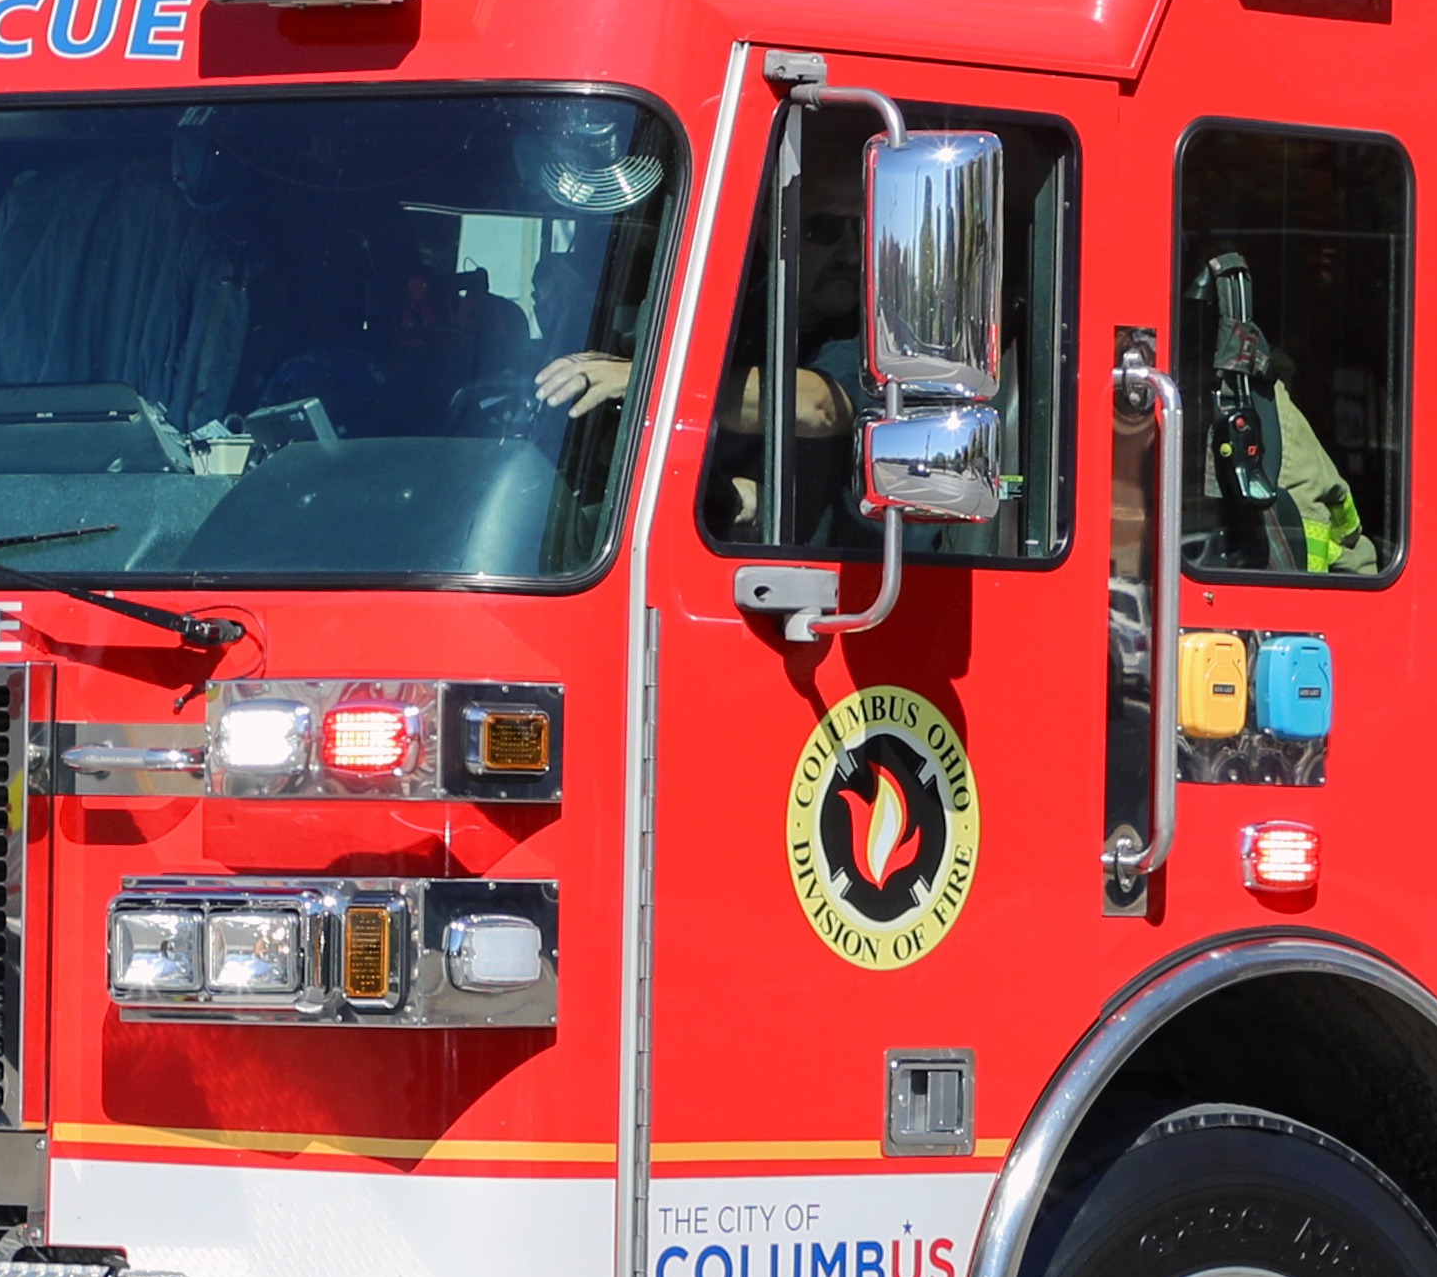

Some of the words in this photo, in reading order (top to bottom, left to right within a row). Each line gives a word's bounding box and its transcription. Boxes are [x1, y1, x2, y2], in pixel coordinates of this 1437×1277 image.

[794, 695, 921, 809] COLUMBUS
[927, 723, 972, 813] OHIO
[792, 839, 881, 964] DIVISION
[892, 922, 927, 961] OF
[931, 843, 973, 931] FIRE
[658, 1206, 709, 1235] THE
[718, 1204, 777, 1233] CITY
[785, 1203, 821, 1231] OF
